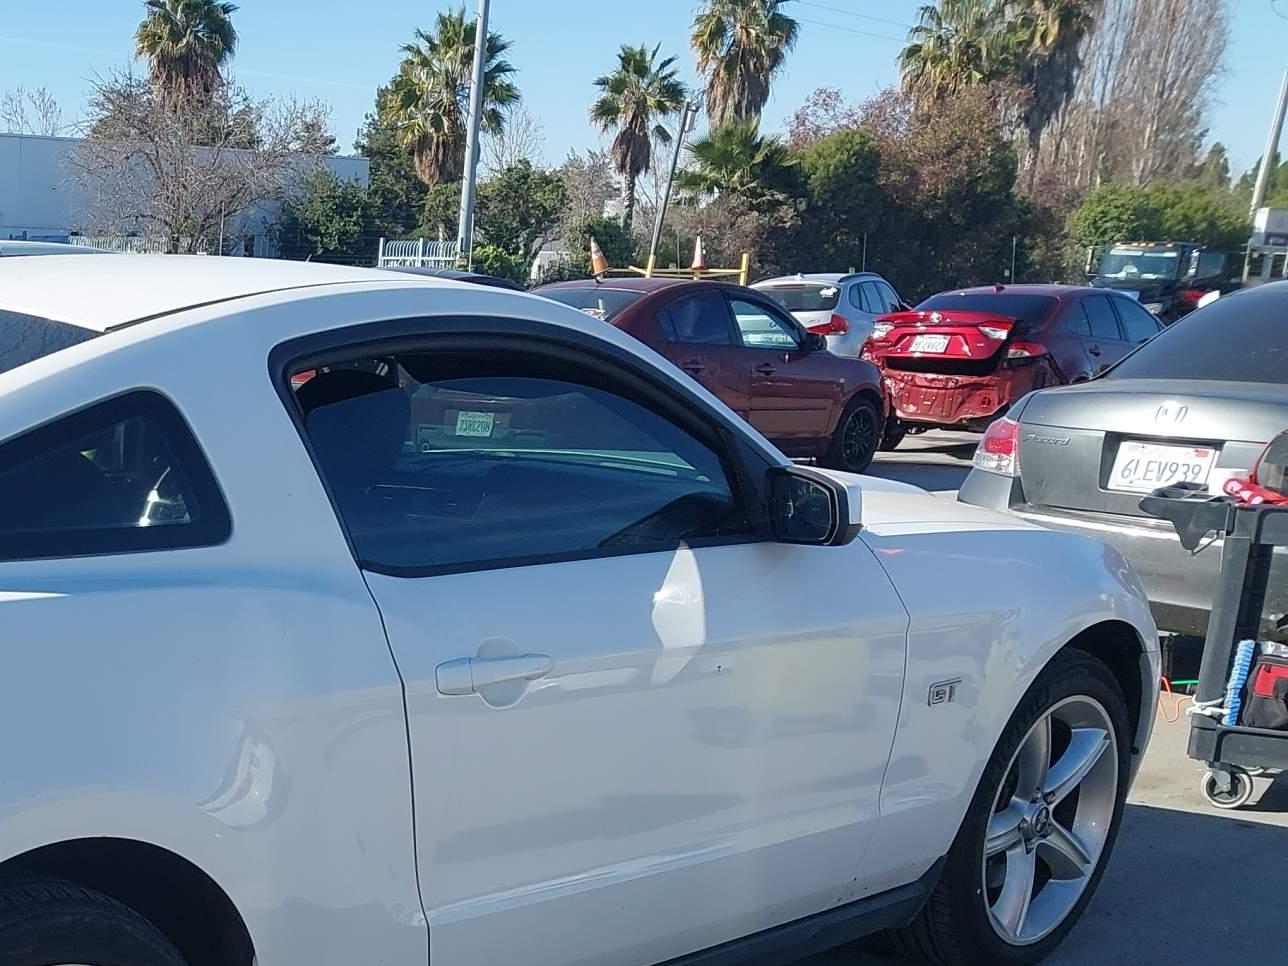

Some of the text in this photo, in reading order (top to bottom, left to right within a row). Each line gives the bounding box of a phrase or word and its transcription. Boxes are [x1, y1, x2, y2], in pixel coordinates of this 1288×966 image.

[1023, 432, 1072, 447] Accord
[1120, 459, 1202, 483] 6LEV939
[927, 676, 962, 708] GT
